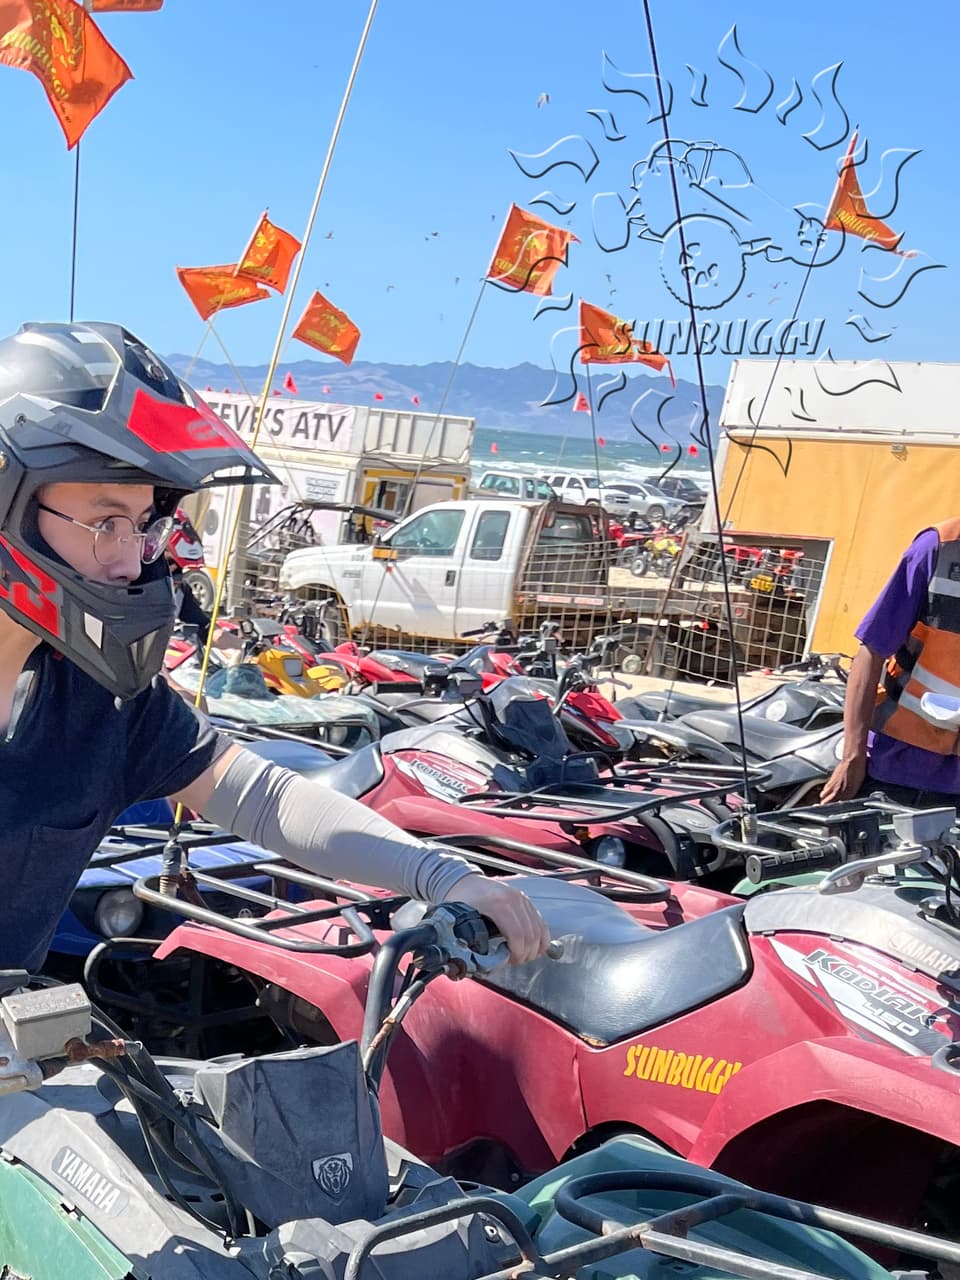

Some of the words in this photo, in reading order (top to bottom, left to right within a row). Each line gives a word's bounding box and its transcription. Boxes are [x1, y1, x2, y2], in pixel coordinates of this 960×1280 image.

[292, 411, 346, 442] ATV
[803, 948, 933, 1030] KODIAK
[862, 1001, 920, 1037] 450
[57, 1148, 121, 1214] YAMAHA
